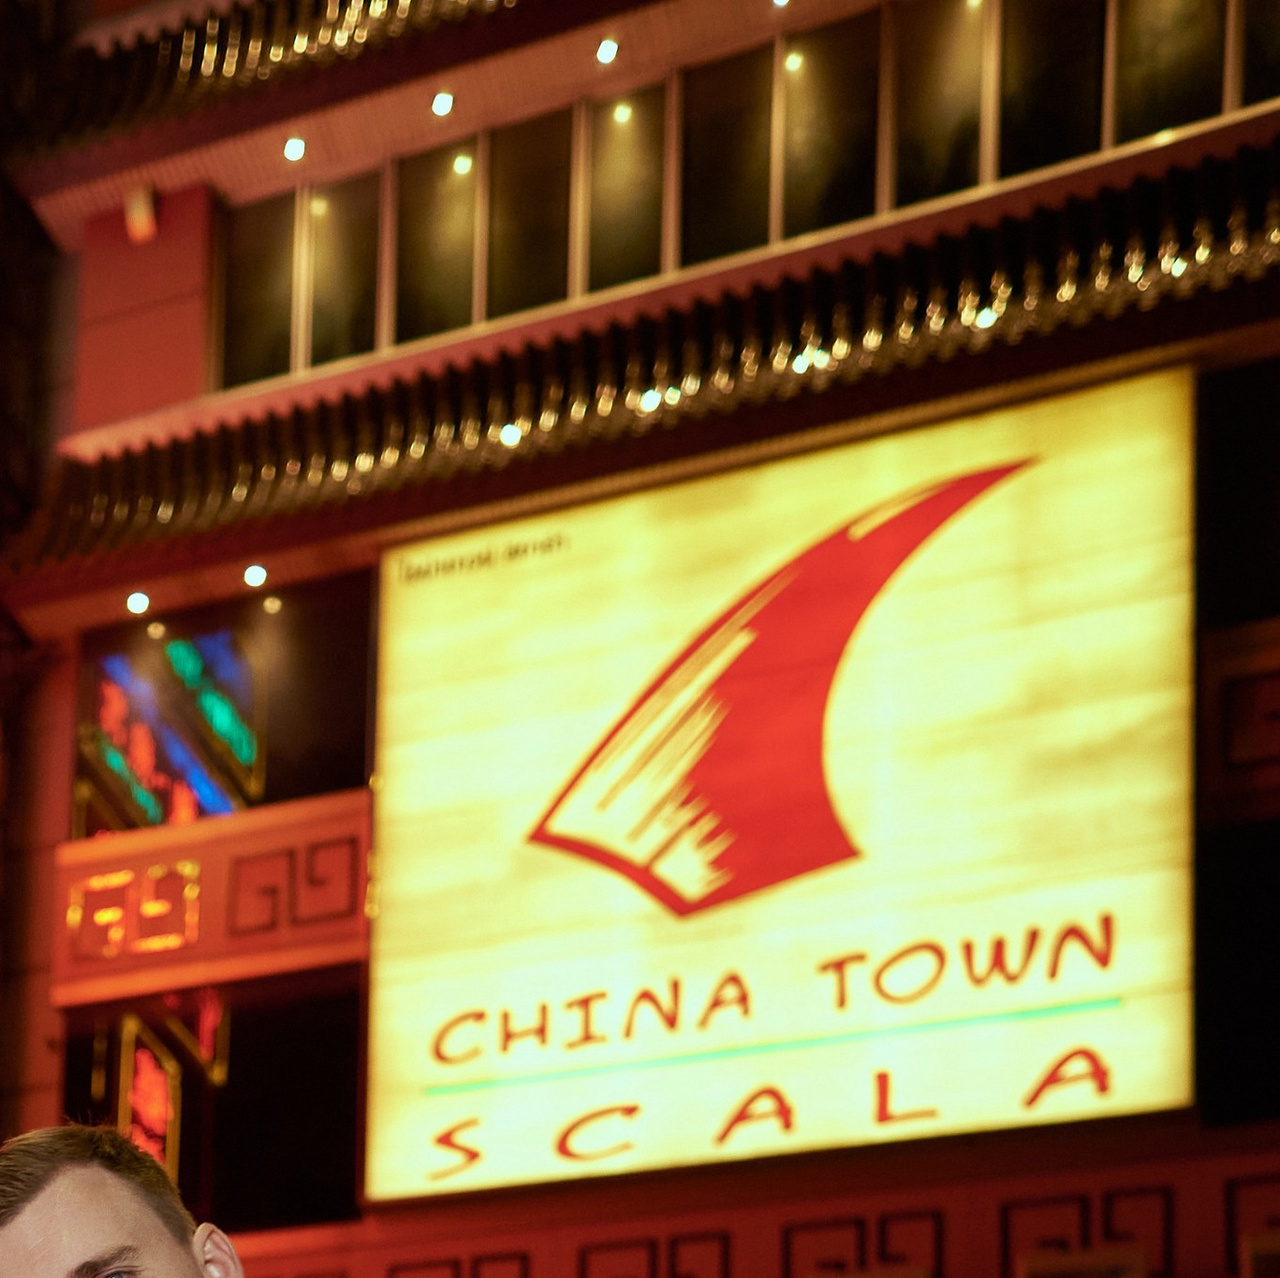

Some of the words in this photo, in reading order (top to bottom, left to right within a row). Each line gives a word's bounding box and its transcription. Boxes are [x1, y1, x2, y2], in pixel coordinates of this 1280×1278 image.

[431, 970, 752, 1065] CHINA
[816, 912, 1115, 1010] TOWN
[426, 1047, 1111, 1182] SCALA
